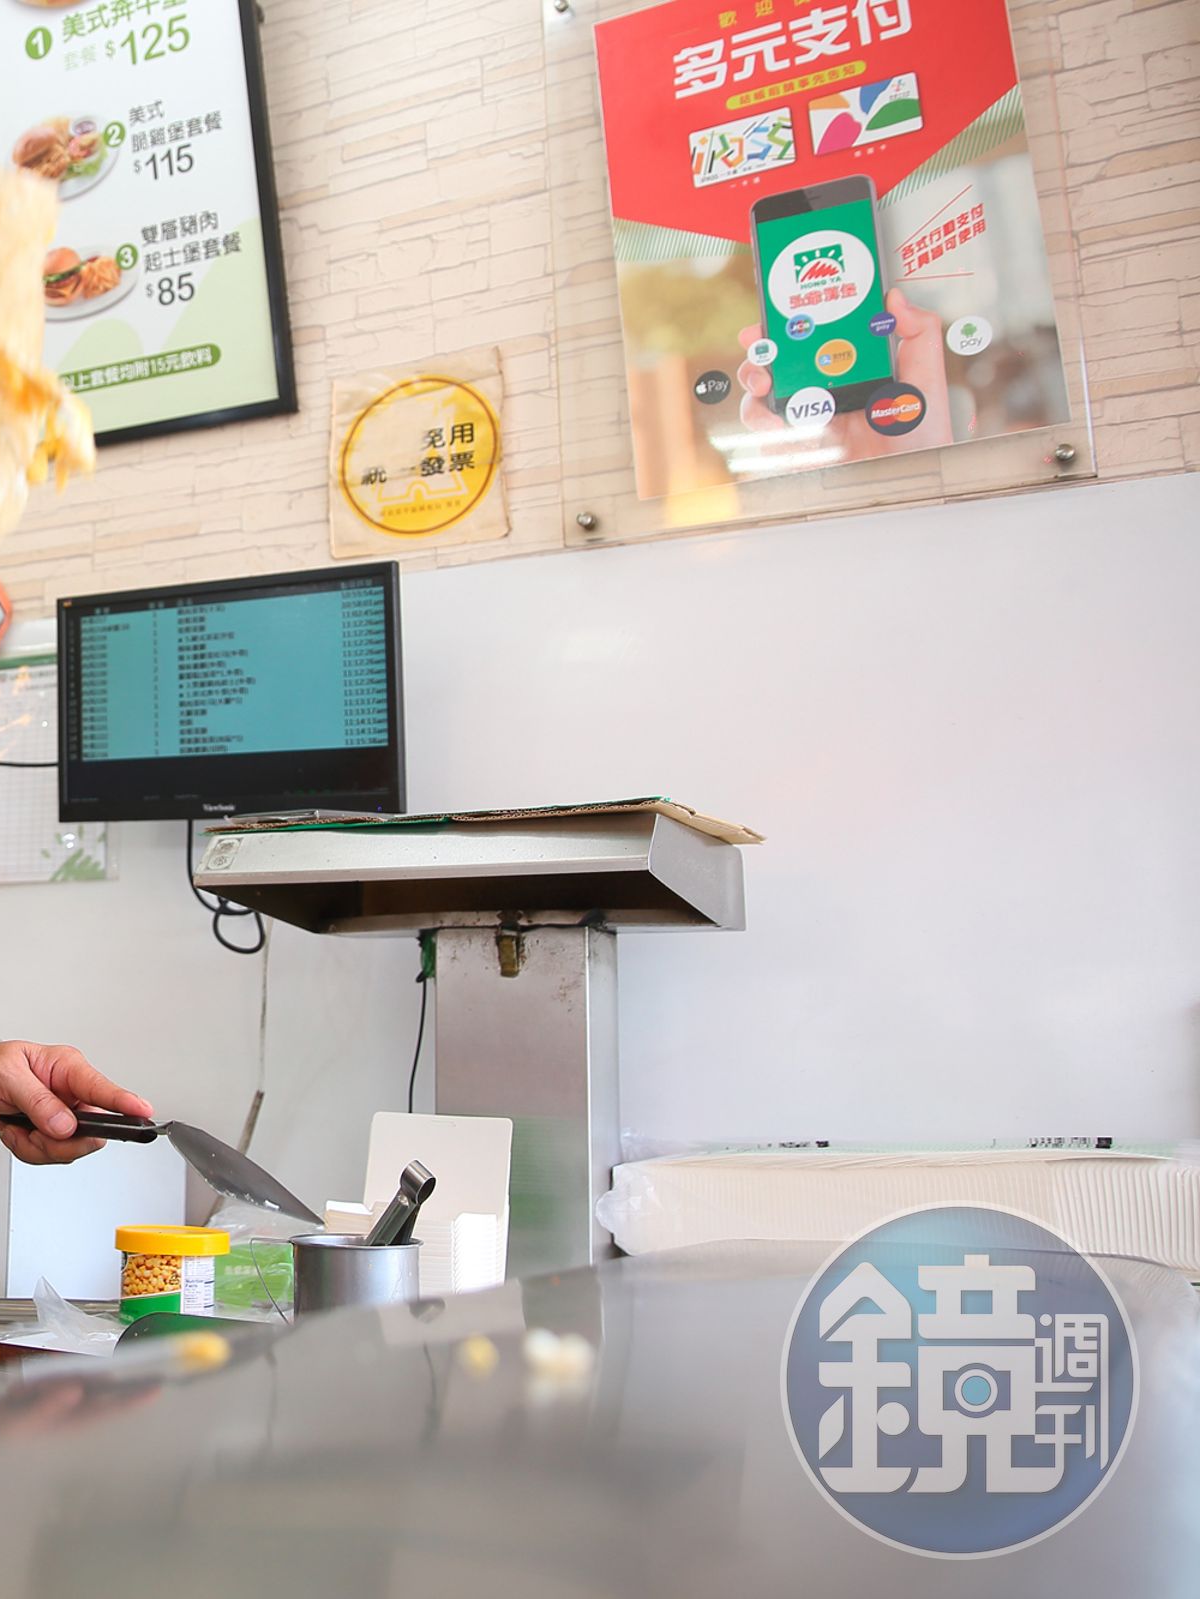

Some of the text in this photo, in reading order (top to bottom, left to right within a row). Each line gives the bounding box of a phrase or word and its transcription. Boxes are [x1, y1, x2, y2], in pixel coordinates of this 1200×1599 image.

[673, 0, 912, 99] 多元支付
[129, 100, 164, 126] 美式
[134, 143, 195, 181] $115
[141, 210, 219, 247] 雙層豬肉
[144, 231, 242, 274] 起士堡套餐
[146, 271, 195, 307] $85
[960, 337, 983, 349] pay
[707, 379, 729, 393] Pay
[789, 399, 833, 419] VISA
[871, 401, 921, 419] MasterCard
